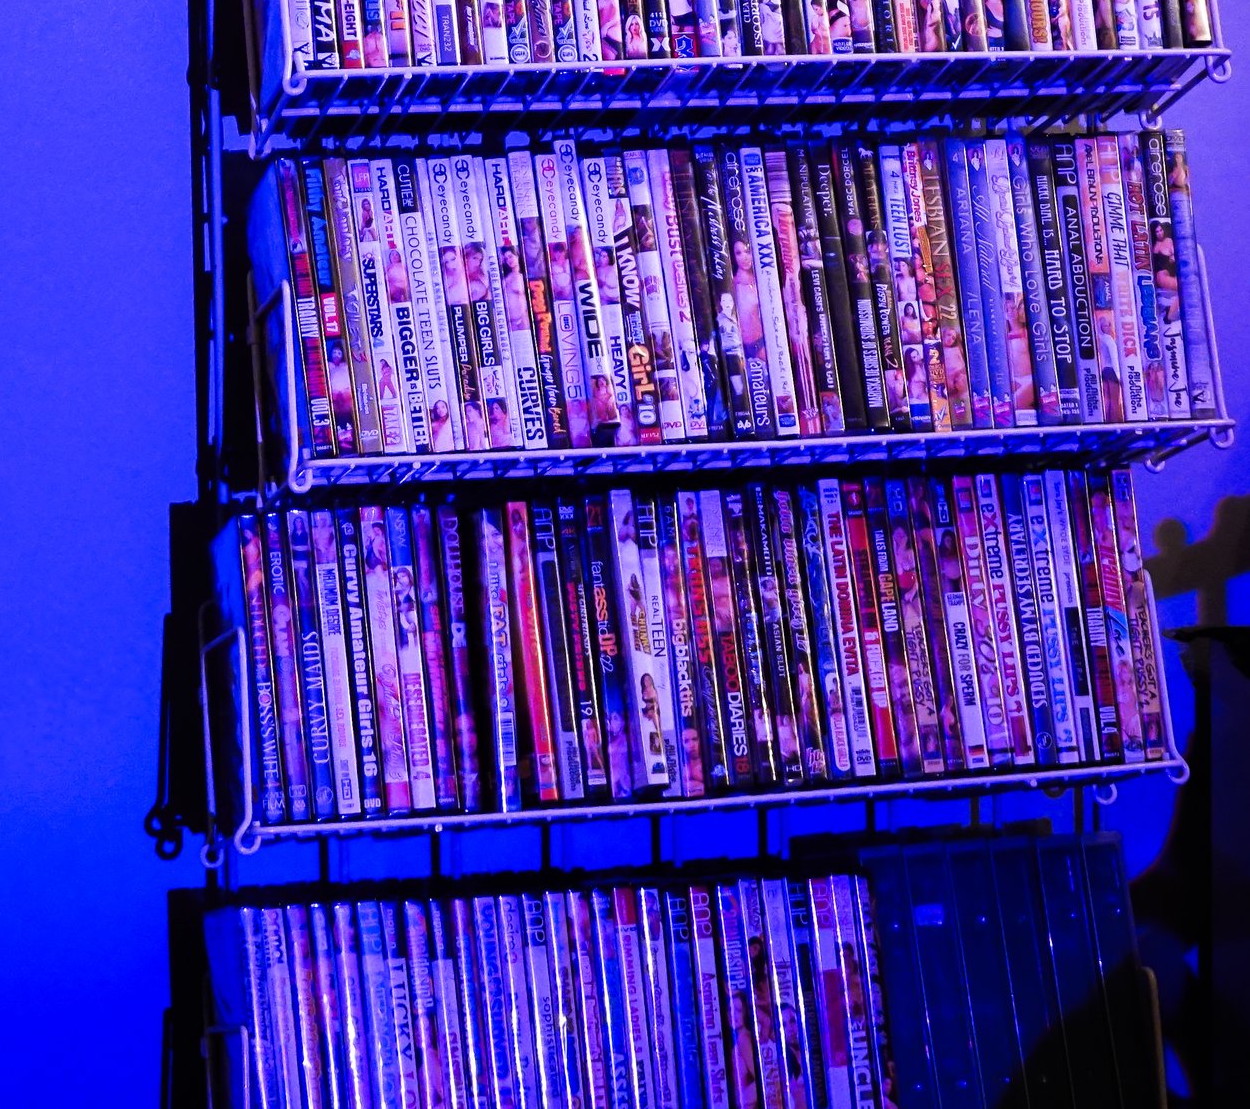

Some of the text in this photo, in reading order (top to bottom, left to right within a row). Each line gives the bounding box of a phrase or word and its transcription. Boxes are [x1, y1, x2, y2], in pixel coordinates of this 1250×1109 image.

[442, 14, 451, 52] TRAN232
[747, 175, 774, 270] AMERICA XXX
[1012, 175, 1048, 361] Girls Who Love Girls
[1065, 207, 1091, 347] ANAL ABDUCTION
[404, 215, 440, 389] CHOCOLATE TEEN SLUTS
[453, 307, 468, 362] PLUMPER
[578, 282, 604, 359] WIDE
[1045, 250, 1071, 363] HARD TO STOP
[396, 308, 428, 446] BIGGER BETTER
[517, 367, 544, 441] CURVES
[827, 512, 859, 676] THE LATIN DOMINA EVITA
[1007, 513, 1048, 708] SEDUCED BY MY SECRETARY
[301, 632, 329, 764] CURVY MAIDS
[343, 544, 377, 776] Curvy Amateur Girls 16
[671, 618, 693, 717] bigblacktits
[952, 622, 975, 706] CRAZY FOR SPERM
[727, 692, 747, 756] DIARIES
